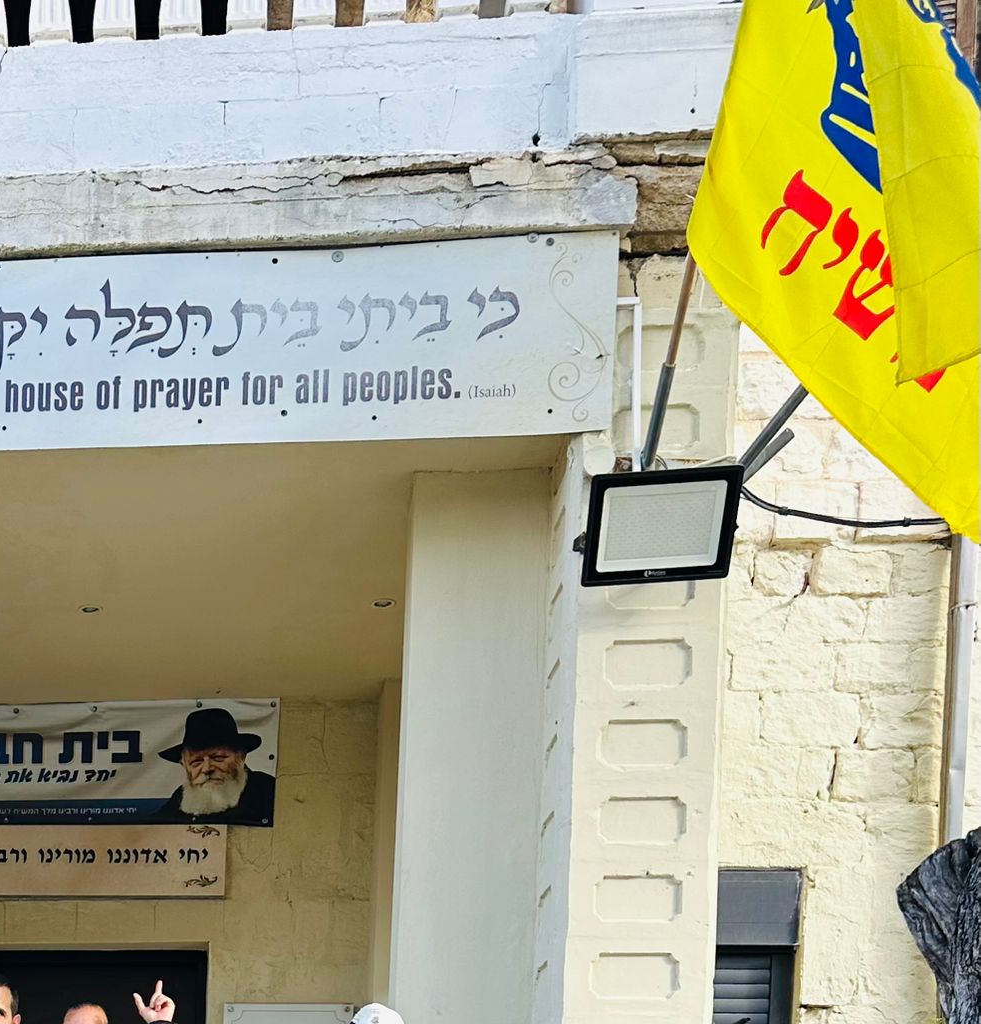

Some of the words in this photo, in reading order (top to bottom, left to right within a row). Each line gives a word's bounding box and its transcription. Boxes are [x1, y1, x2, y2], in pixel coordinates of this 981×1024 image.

[4, 379, 85, 413] house
[96, 375, 122, 411] of
[133, 376, 230, 413] prayer
[241, 371, 284, 406] for
[294, 368, 330, 404] all
[342, 365, 462, 407] peoples.
[467, 383, 517, 400] (Isaiah)
[58, 730, 143, 764] בית
[4, 767, 33, 784] את
[37, 767, 80, 783] נביא
[38, 847, 96, 864] מורינו
[107, 847, 168, 864] אדוננו
[178, 847, 209, 864] יחי
